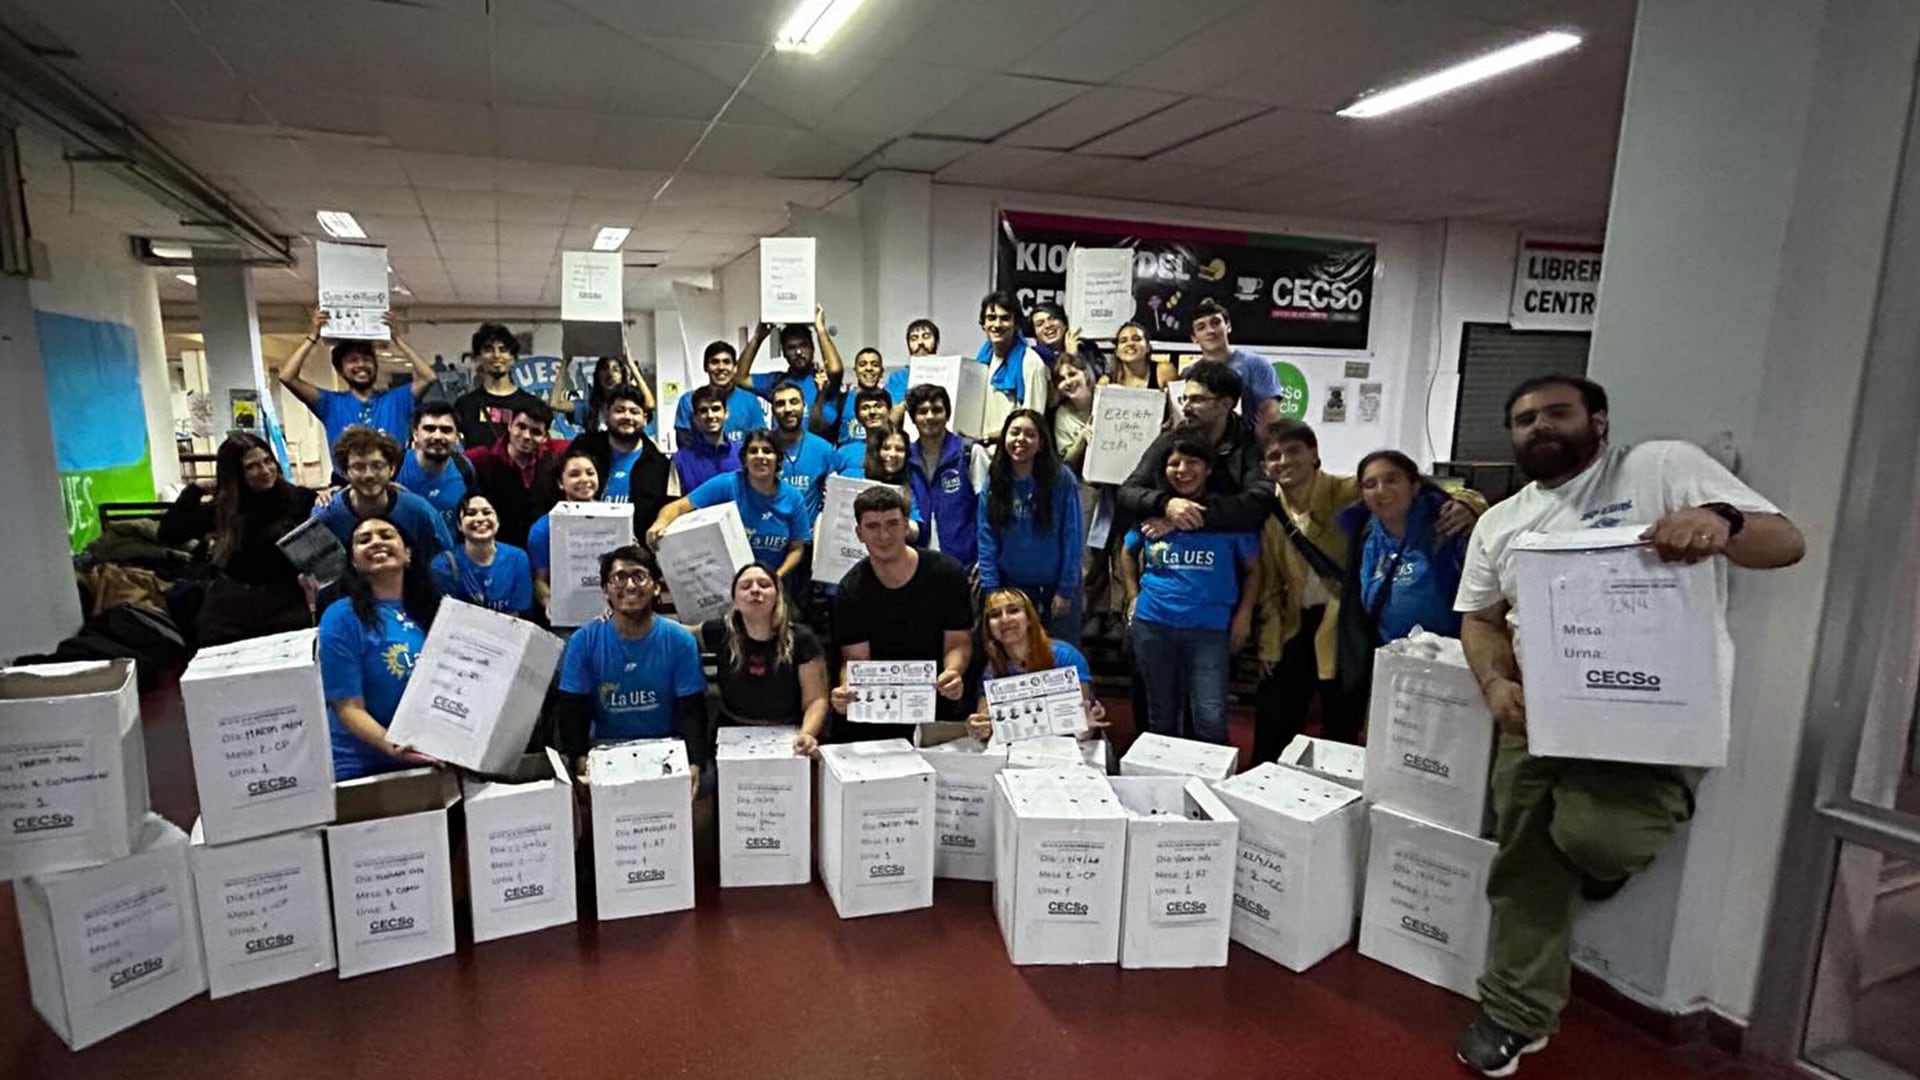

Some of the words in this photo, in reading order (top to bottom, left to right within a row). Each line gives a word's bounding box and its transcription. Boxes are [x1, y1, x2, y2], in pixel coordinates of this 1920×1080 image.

[1016, 242, 1068, 273] KIO
[1528, 256, 1601, 281] LIBRER
[1272, 277, 1362, 310] CECSo
[1524, 290, 1595, 314] CENTR
[515, 361, 562, 387] UES
[1162, 551, 1179, 565] La
[1184, 551, 1215, 565] UES
[1586, 669, 1661, 686] CECSo
[433, 695, 470, 715] CECSo
[611, 692, 626, 706] La
[630, 690, 657, 706] UES
[1404, 753, 1450, 775] CECSo
[247, 776, 297, 794] CECSo
[13, 813, 74, 830] CECSo
[746, 837, 780, 846] CECSo
[940, 834, 976, 845] CECSo
[628, 868, 665, 881] CECSo
[870, 864, 905, 875] CECSo
[504, 884, 544, 898] CECSo
[1048, 901, 1088, 912] CECSo
[1165, 901, 1207, 912] CECSo
[1233, 893, 1271, 918] CECSo
[370, 917, 414, 931] CECSo
[1402, 916, 1449, 941] CECSo
[246, 934, 294, 951] CECSo
[109, 957, 163, 984] CECSo
